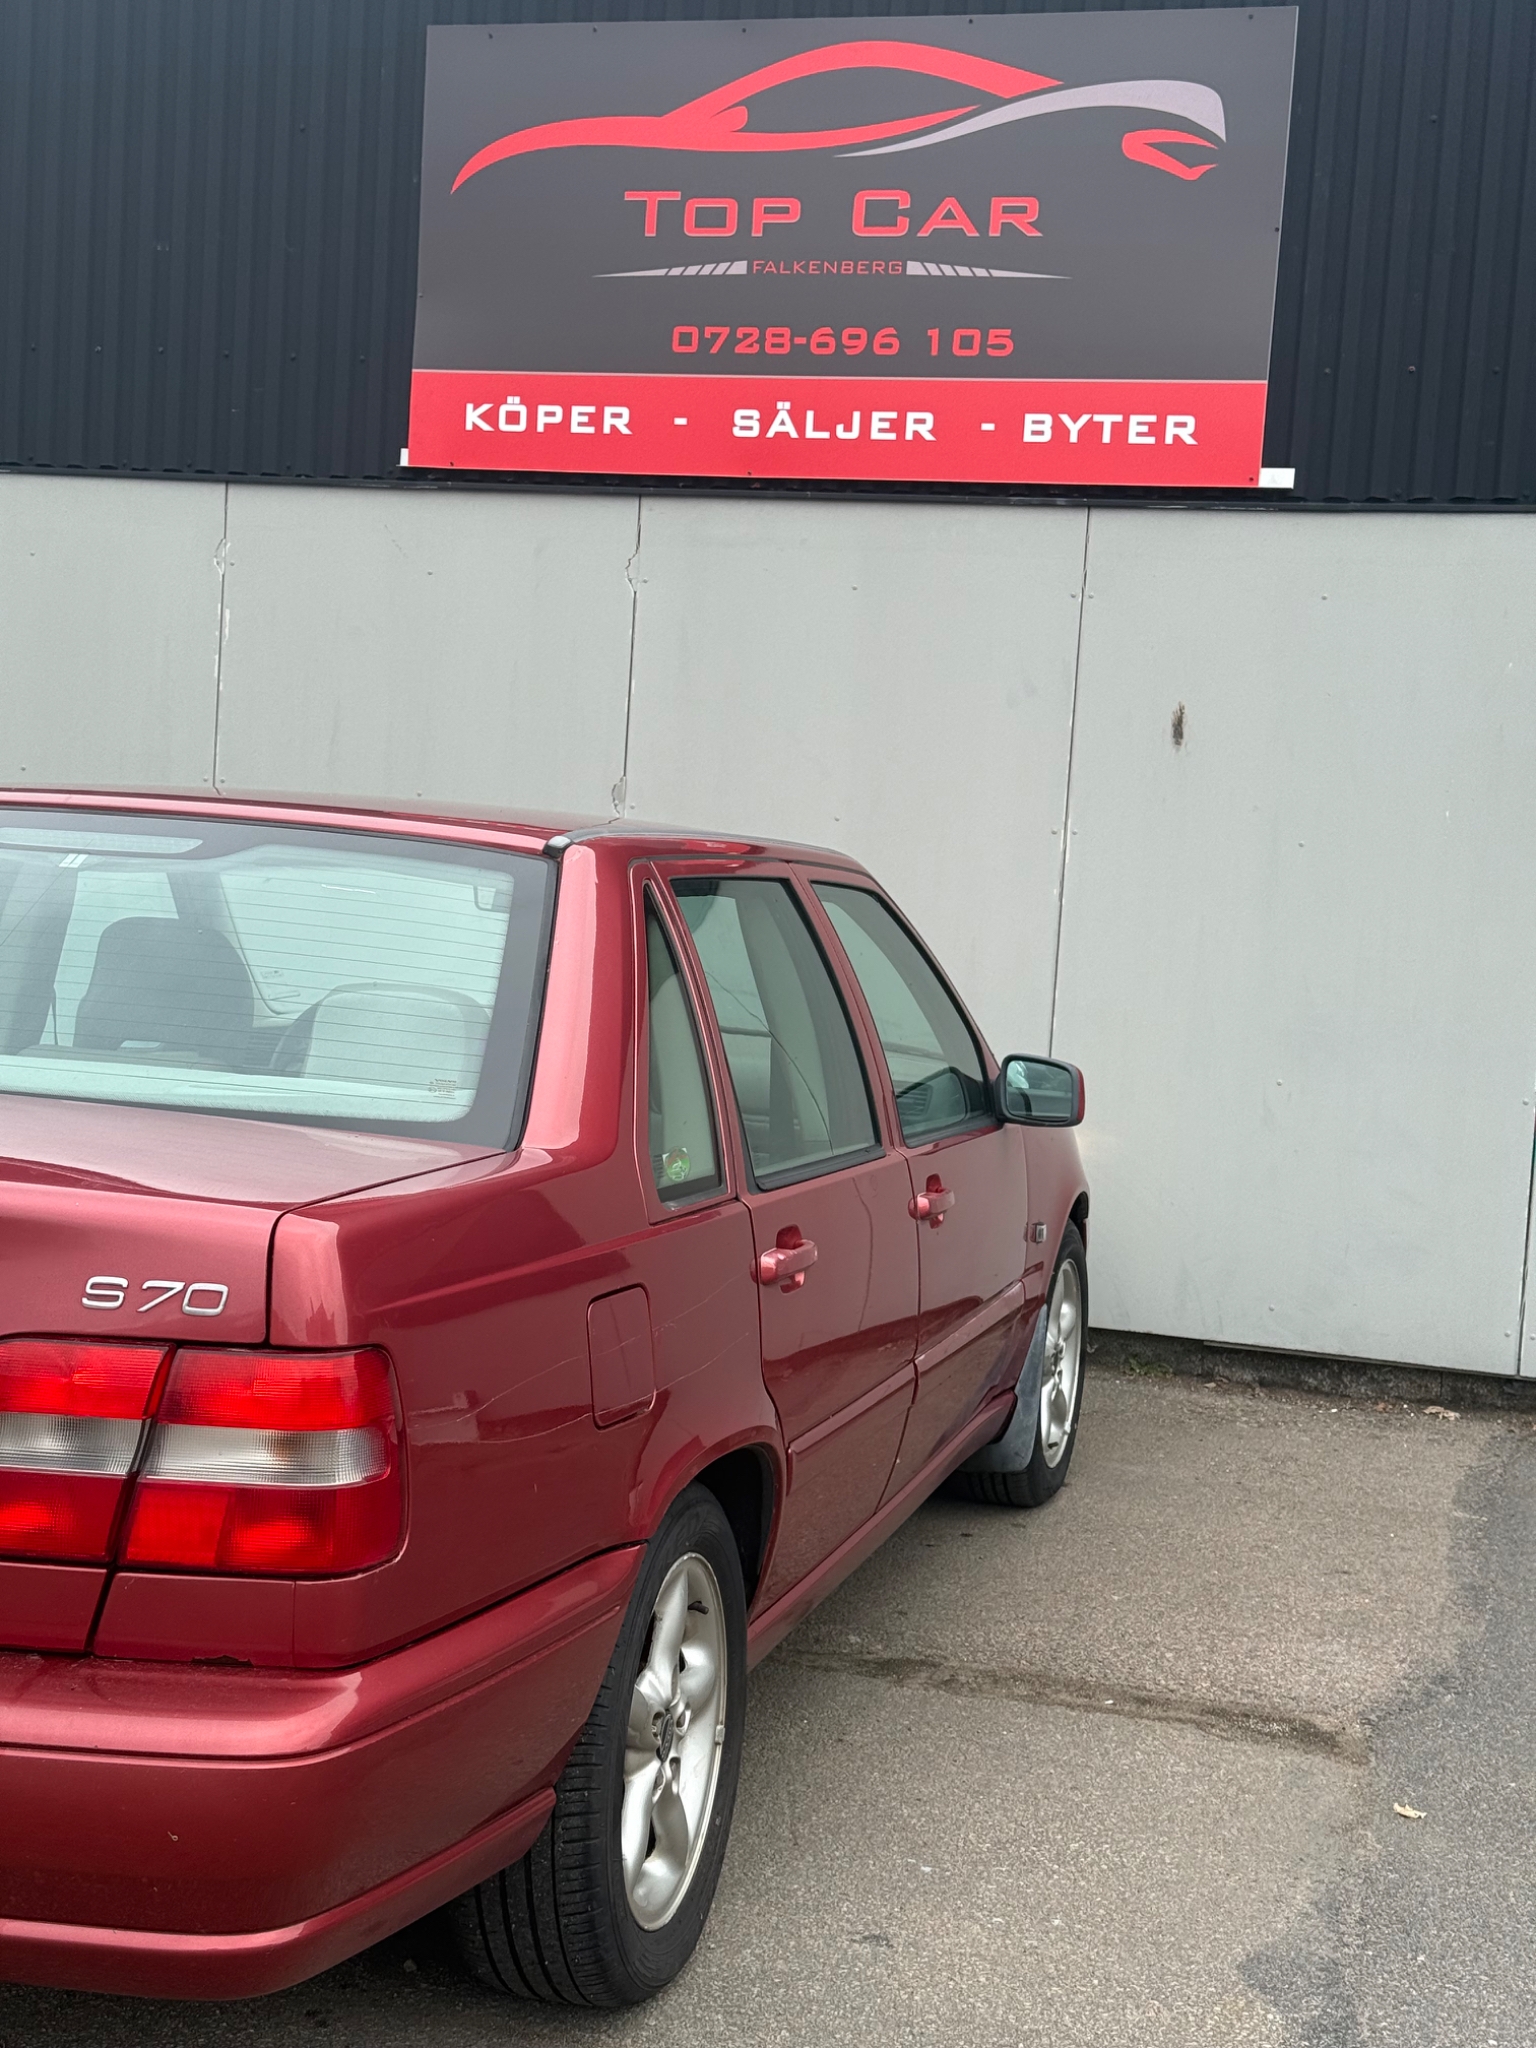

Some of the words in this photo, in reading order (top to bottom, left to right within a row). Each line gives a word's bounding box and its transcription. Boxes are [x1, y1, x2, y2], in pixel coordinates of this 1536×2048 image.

[624, 190, 802, 238] TOP
[851, 189, 1044, 238] CAR
[752, 260, 903, 275] FALKENBERG
[671, 325, 901, 356] 0728-696
[927, 327, 1015, 357] 105
[464, 395, 634, 435] KÖPER
[732, 400, 938, 442] SÄLJER
[1022, 412, 1199, 445] BYTER
